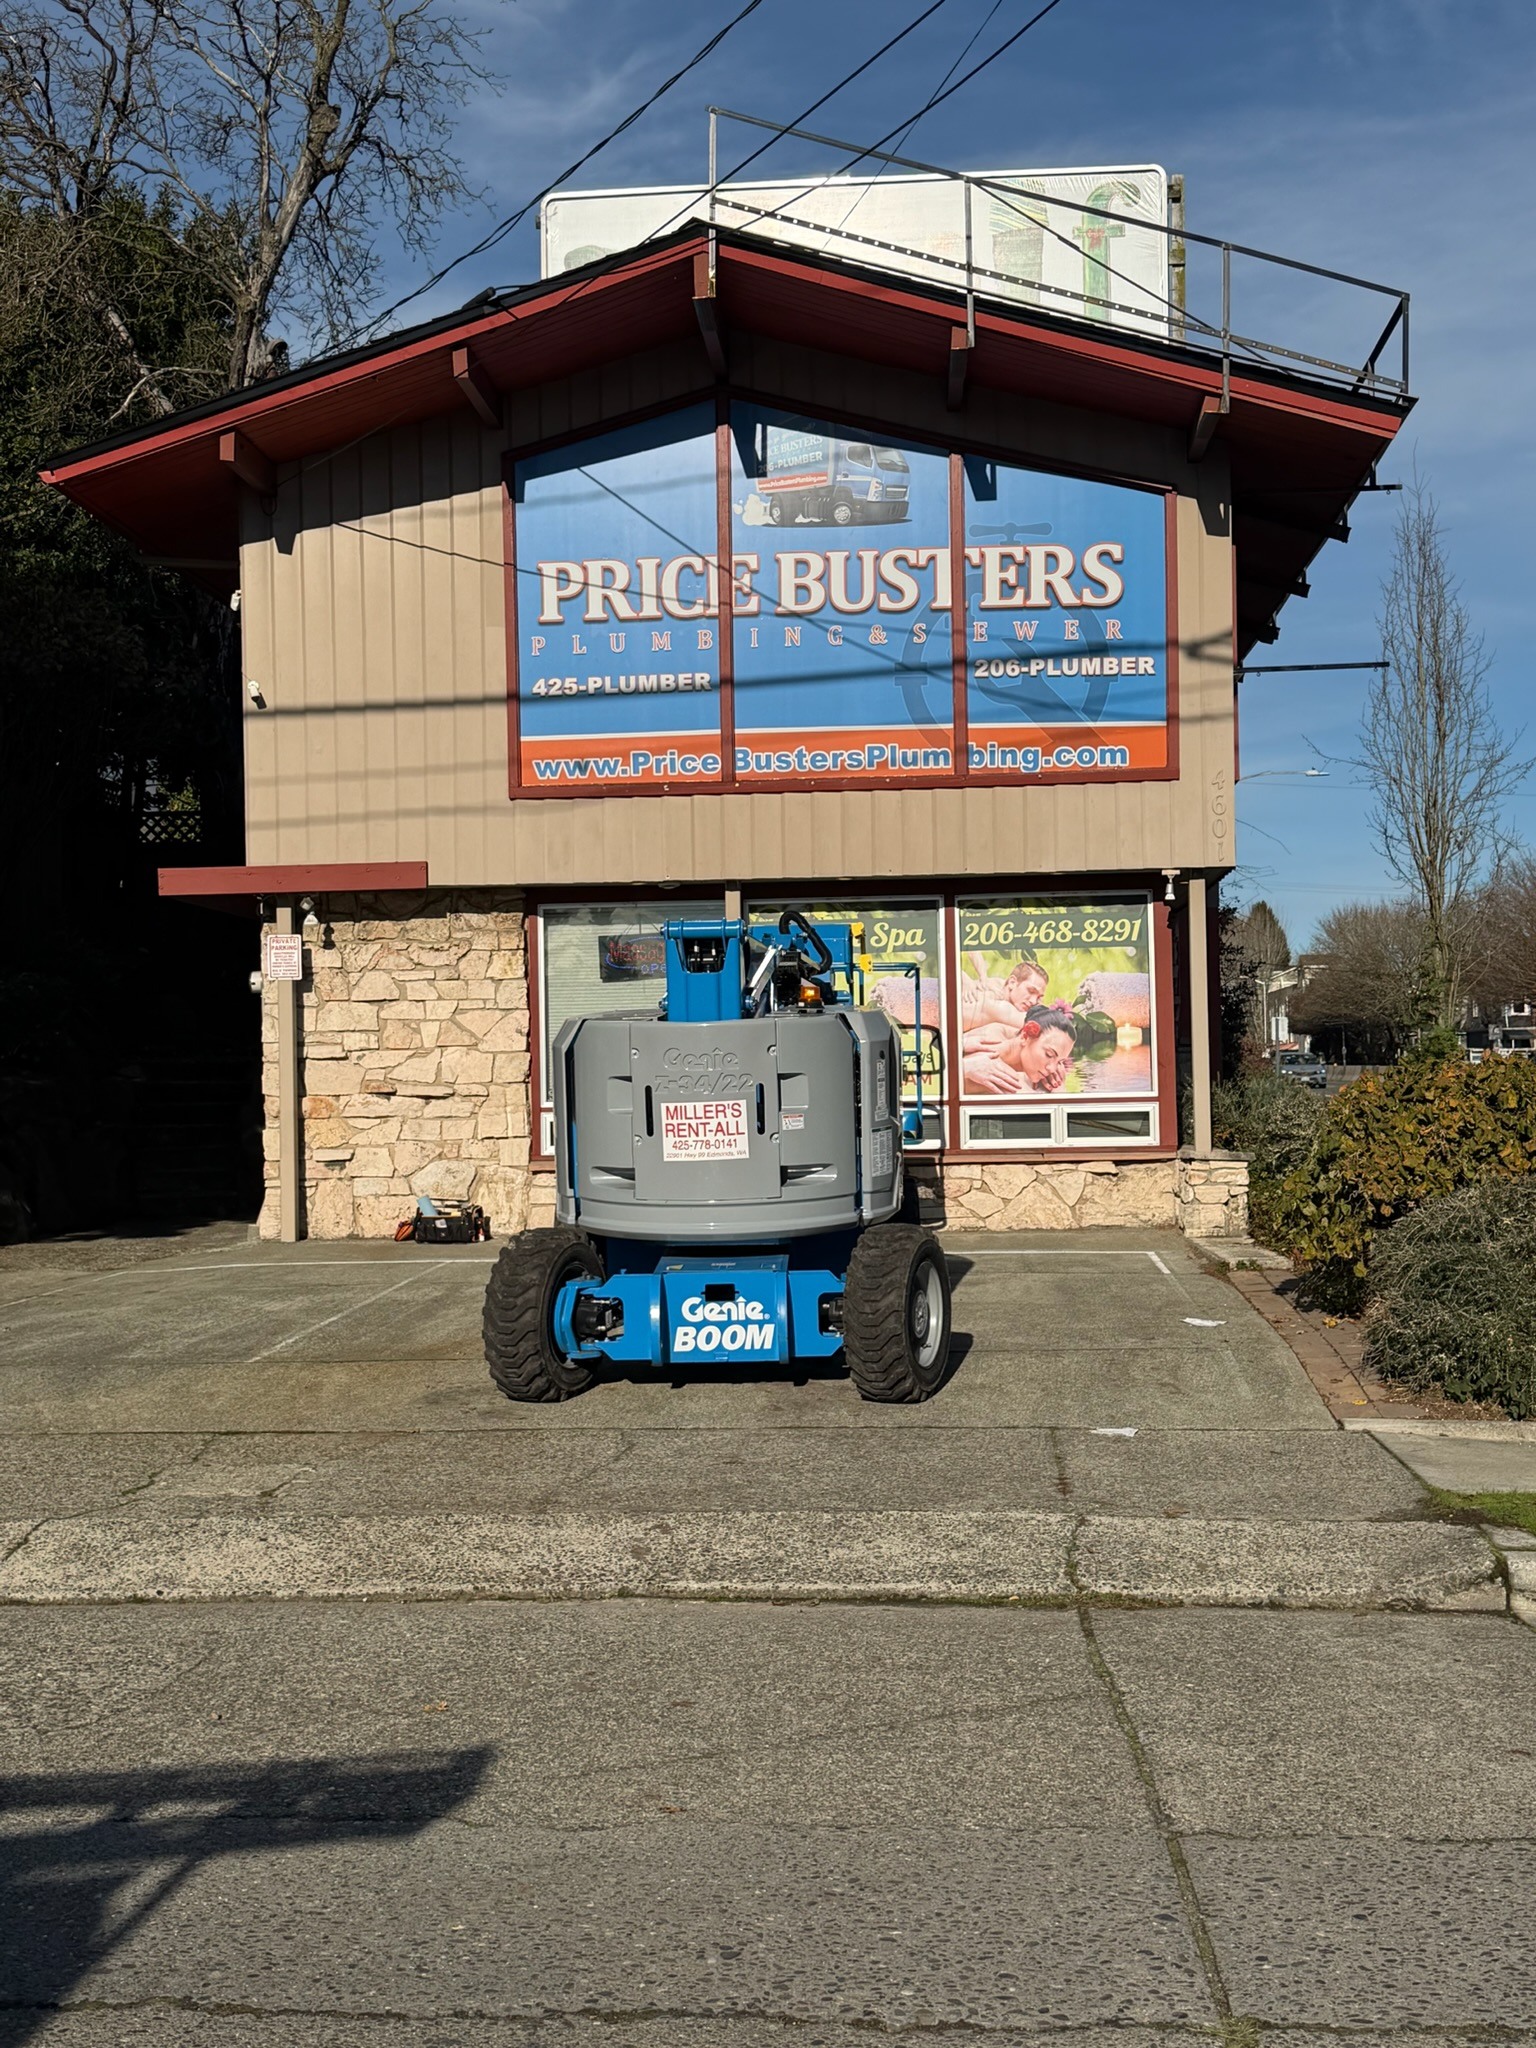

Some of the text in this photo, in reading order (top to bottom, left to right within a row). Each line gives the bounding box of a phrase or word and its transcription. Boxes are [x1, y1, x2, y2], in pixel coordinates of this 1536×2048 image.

[781, 435, 823, 453] BUSTERS
[758, 451, 823, 473] 206-PLUMBER
[536, 543, 1124, 625] PRICE BUSTERS
[531, 619, 1123, 656] PLUMBING & SEWER
[974, 656, 1156, 678] 206-PLUMBER
[531, 672, 712, 697] 425-PLUMBER
[532, 743, 1129, 780] www.PriceBustersPlumbing.com
[1212, 769, 1227, 863] 4601
[870, 922, 926, 953] Spa
[964, 918, 1142, 946] 206-468-8291
[663, 1047, 739, 1071] Genie
[655, 1072, 755, 1095] Z-34/22
[665, 1102, 742, 1121] MILLER'S
[665, 1120, 746, 1138] RENT-ALL
[672, 1138, 737, 1151] 425-778-0141
[681, 1296, 764, 1322] Genie
[673, 1323, 775, 1352] BOOM
